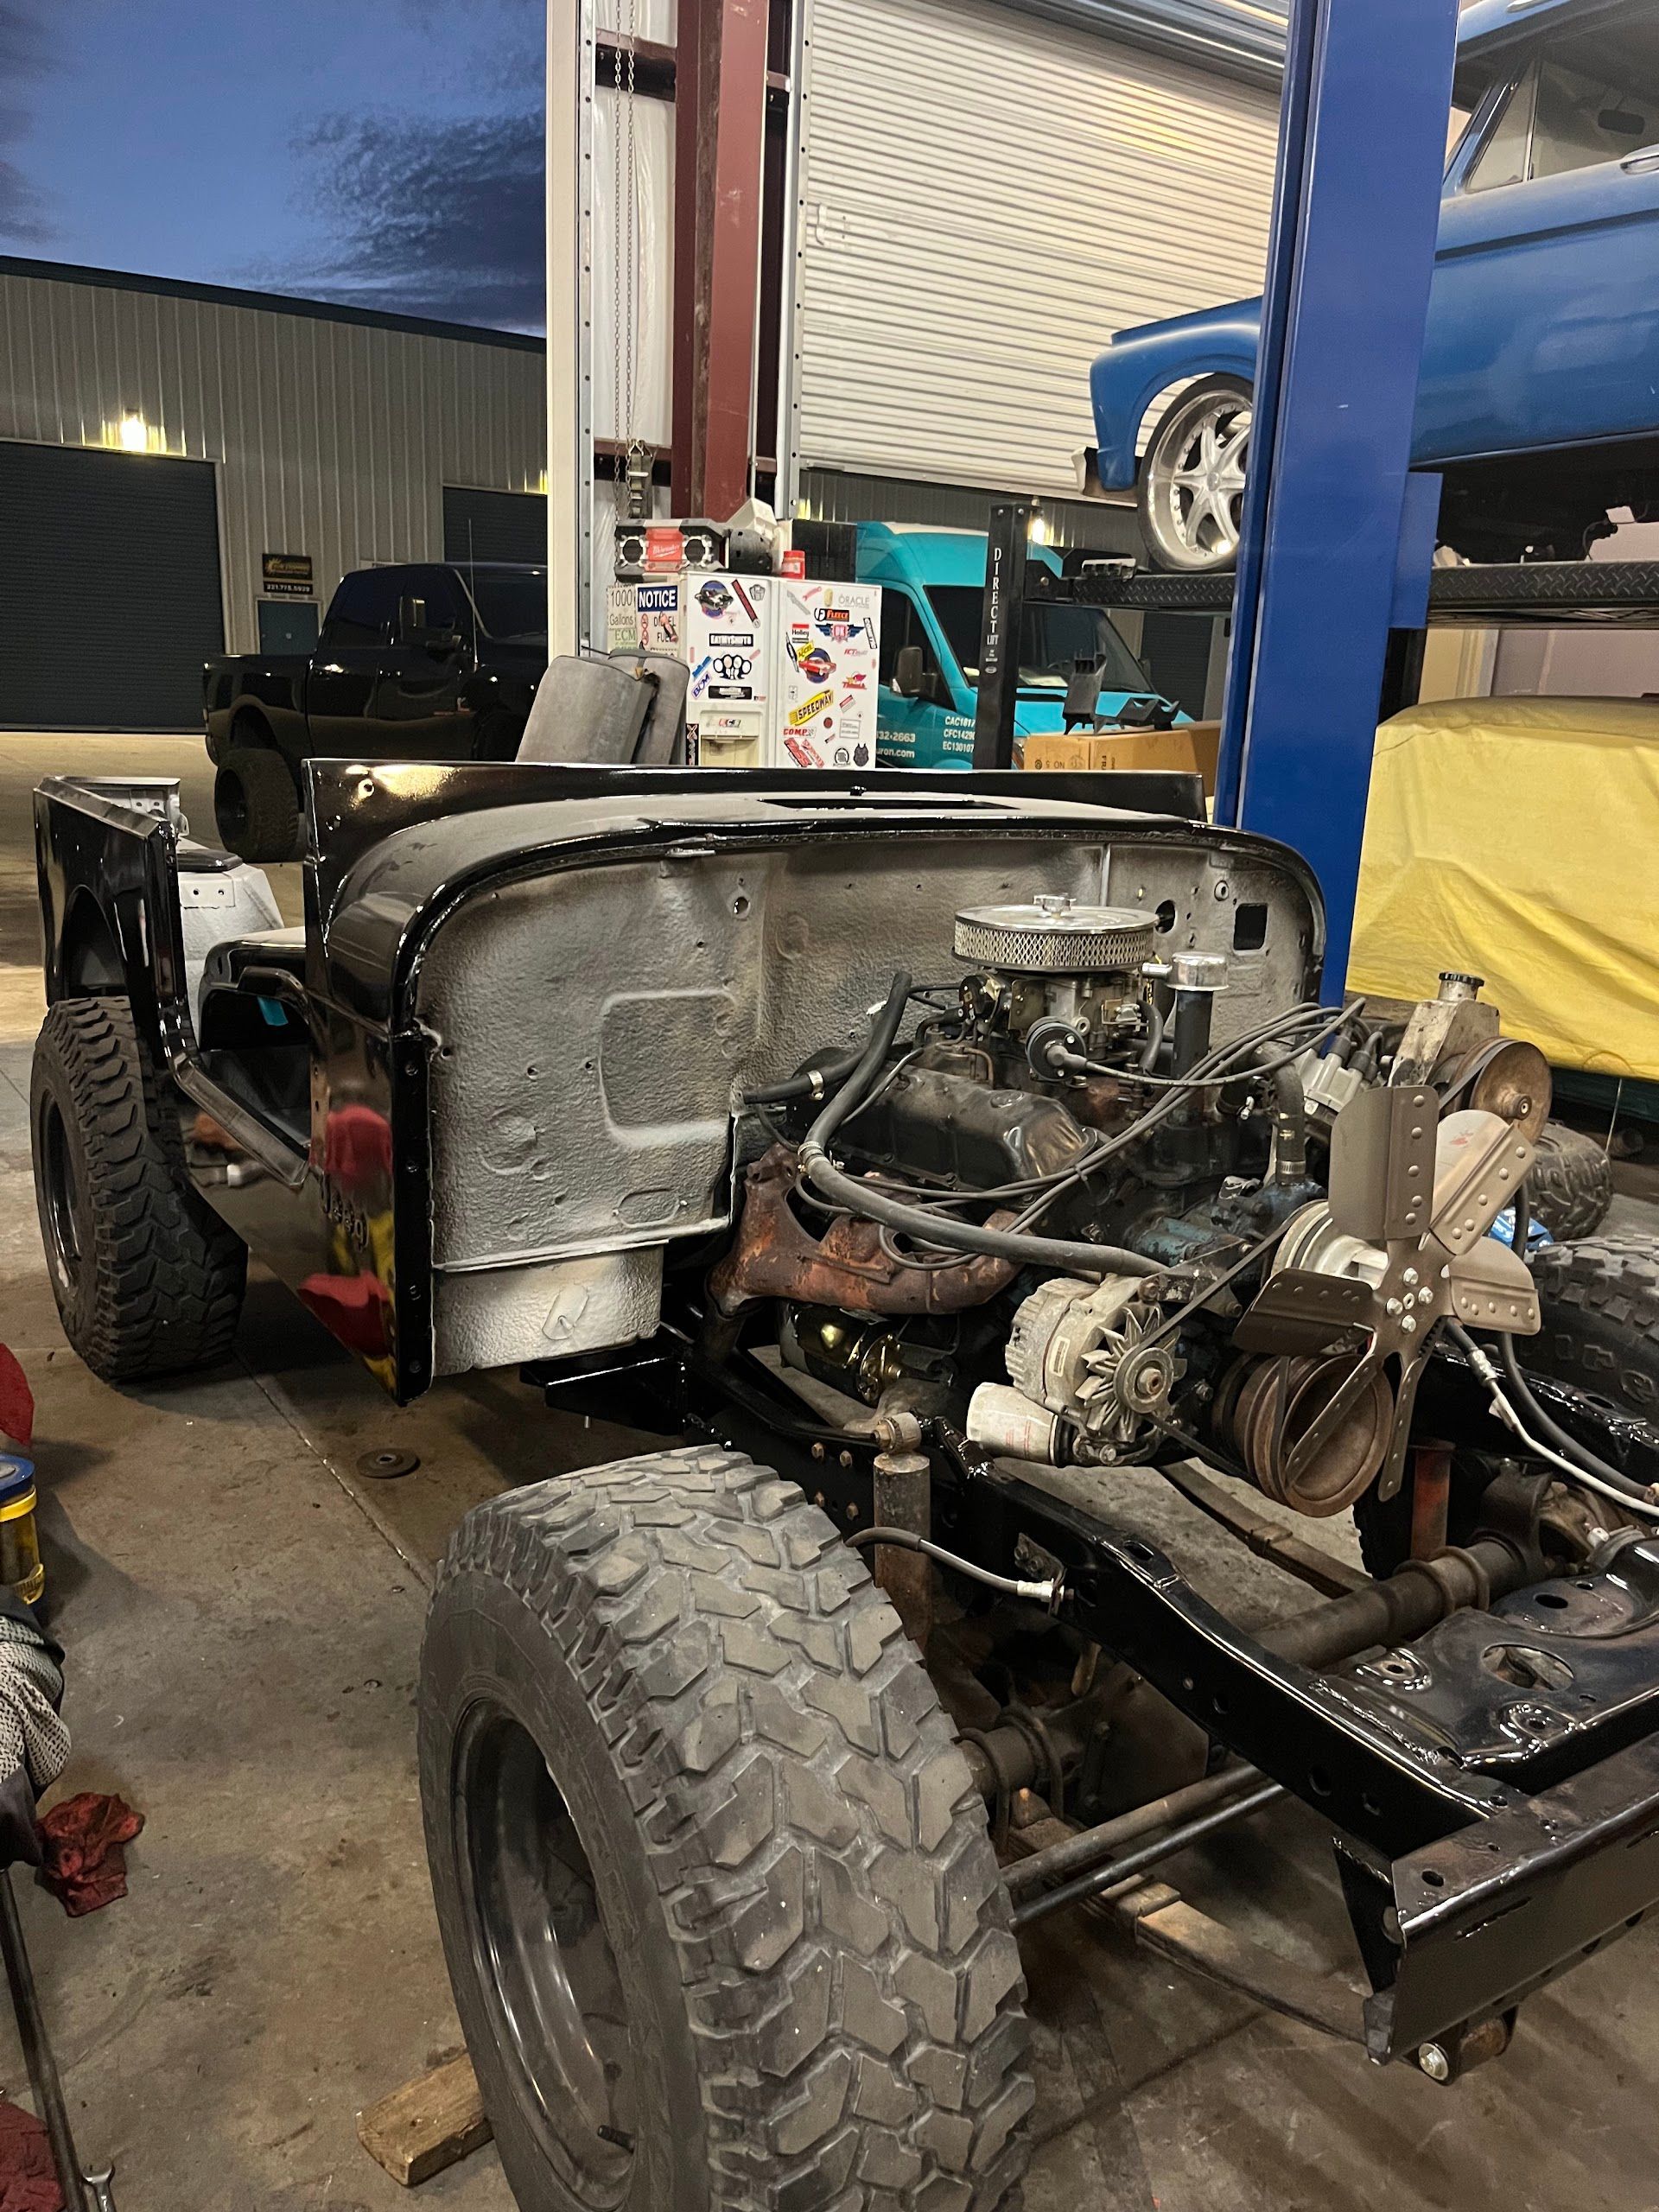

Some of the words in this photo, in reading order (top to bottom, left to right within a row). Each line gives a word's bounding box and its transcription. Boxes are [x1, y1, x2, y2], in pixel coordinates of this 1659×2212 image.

[611, 589, 632, 607] 1000
[638, 589, 677, 608] NOTICE
[990, 548, 1001, 633] DIRECT
[609, 614, 634, 626] Gallons
[614, 629, 636, 641] ECM
[798, 692, 833, 720] SPEEDWAY
